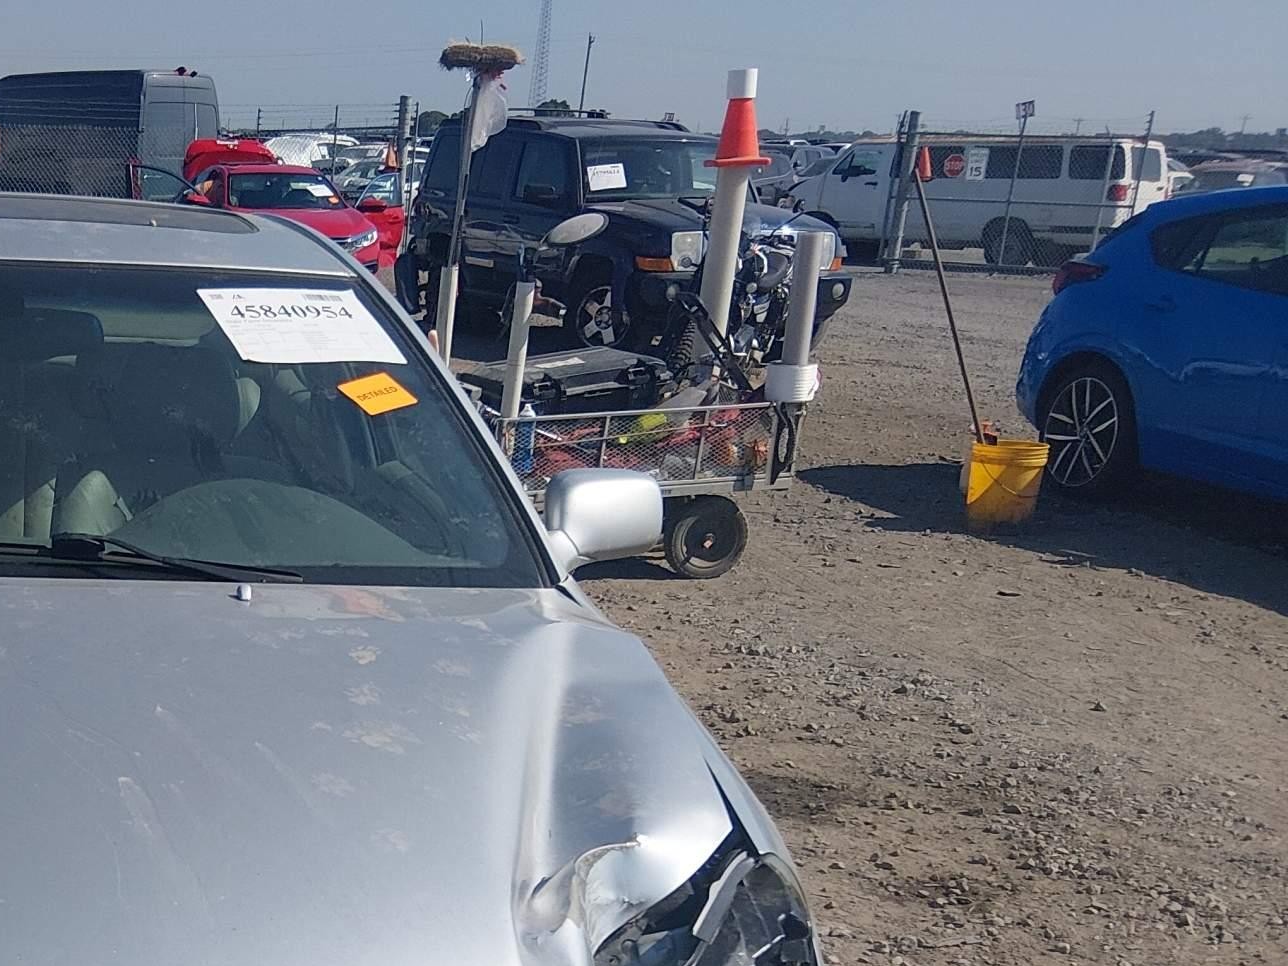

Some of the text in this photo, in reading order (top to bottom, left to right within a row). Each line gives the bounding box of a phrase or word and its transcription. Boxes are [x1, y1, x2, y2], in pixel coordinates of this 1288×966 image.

[946, 160, 964, 171] STOP
[969, 166, 982, 177] 15
[231, 304, 353, 319] 45840954
[356, 386, 398, 402] DETAILED
